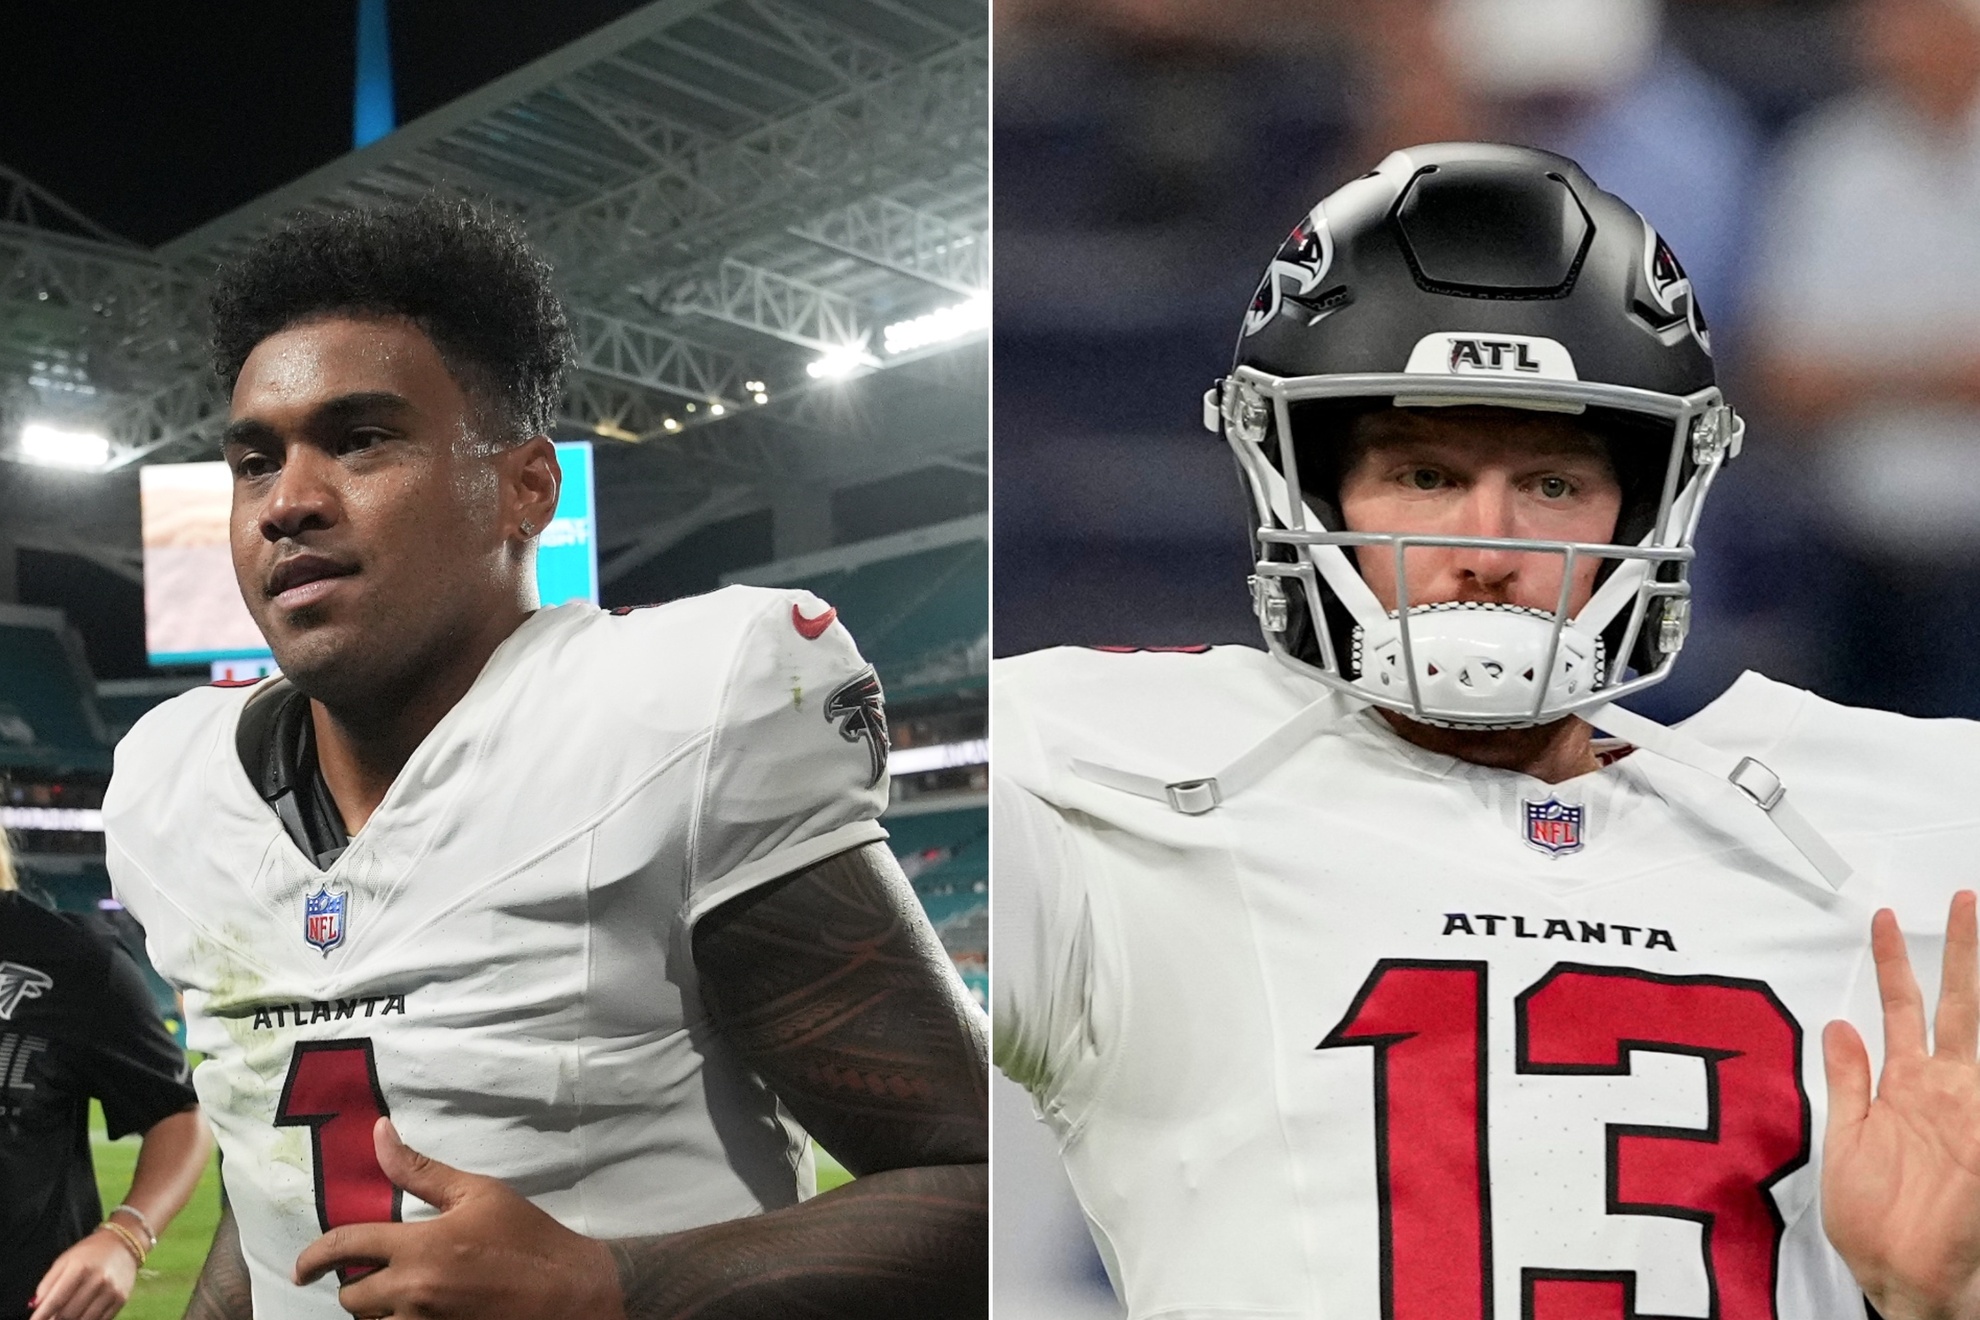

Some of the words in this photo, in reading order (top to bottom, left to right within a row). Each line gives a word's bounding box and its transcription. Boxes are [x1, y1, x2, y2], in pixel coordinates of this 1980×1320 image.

[1447, 338, 1541, 373] ATL
[1533, 820, 1576, 846] NFL
[308, 915, 338, 943] NFL
[1442, 912, 1678, 952] ATLANTA
[253, 993, 406, 1030] ATLANTA
[1315, 957, 1812, 1320] 13
[274, 1036, 404, 1310] 1
